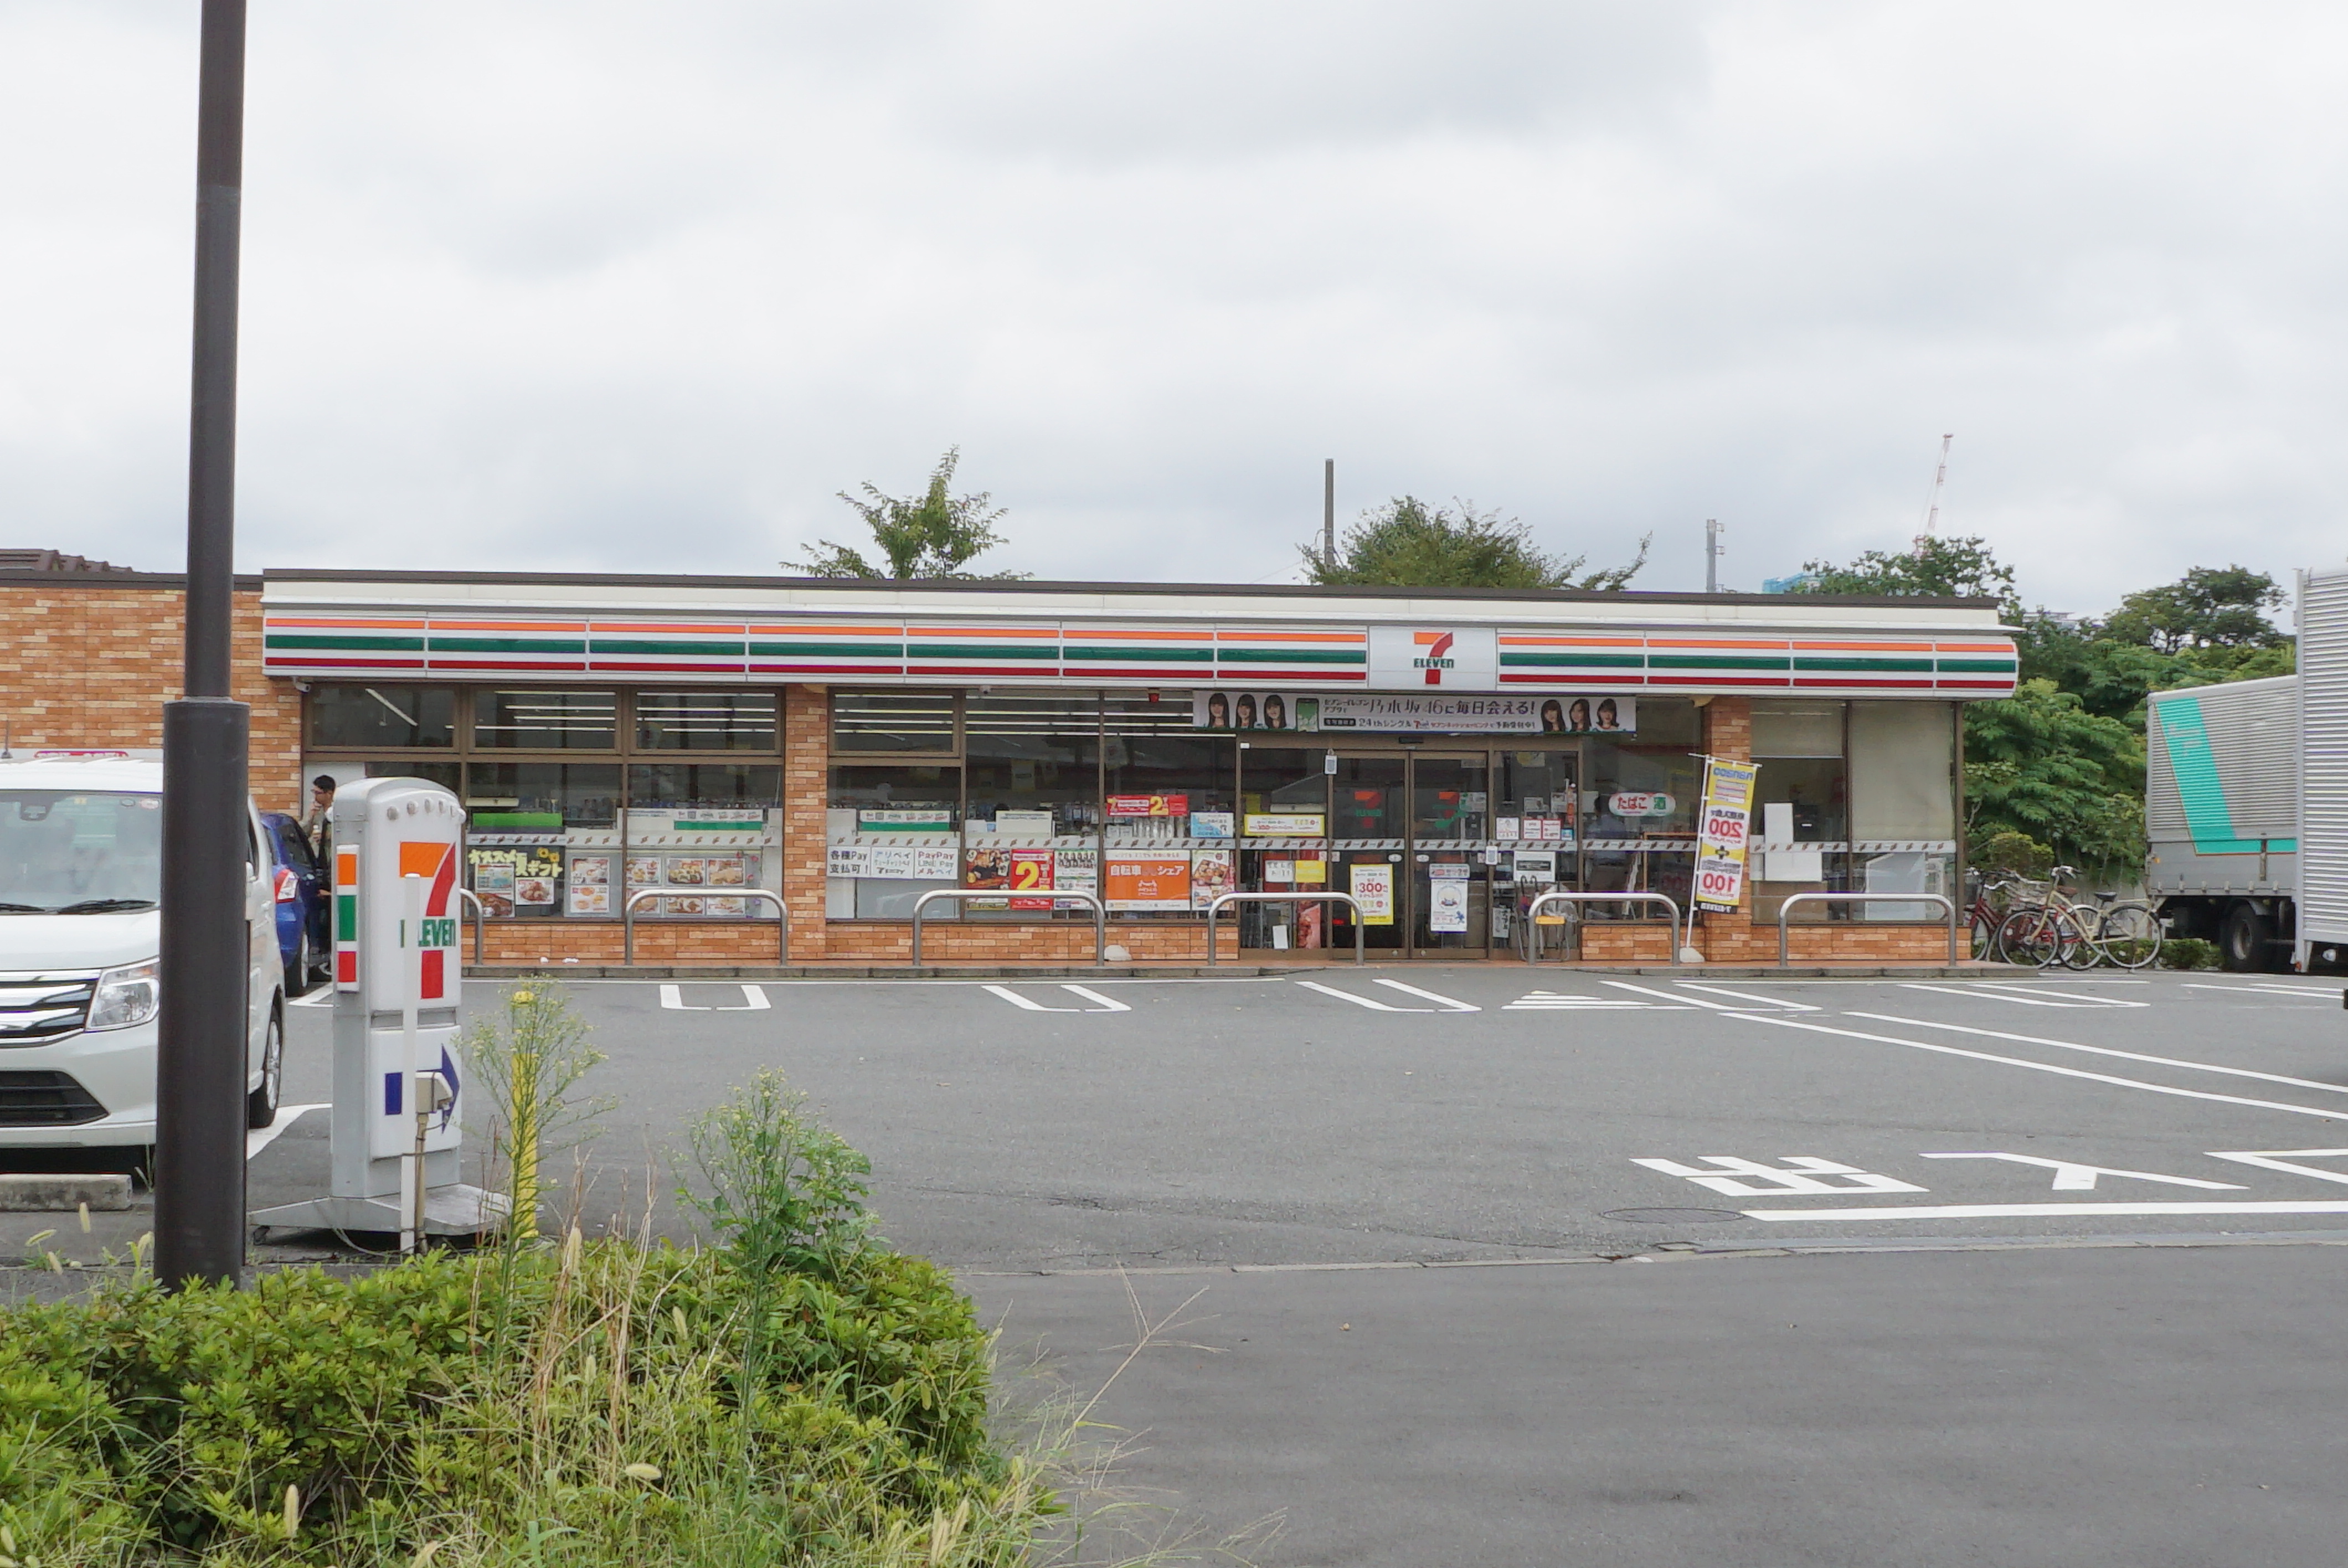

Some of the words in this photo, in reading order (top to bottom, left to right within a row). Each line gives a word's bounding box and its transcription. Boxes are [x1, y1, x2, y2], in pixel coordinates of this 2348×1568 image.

[1414, 632, 1453, 684] 7
[1617, 796, 1648, 809] たばこ
[399, 841, 456, 999] 7
